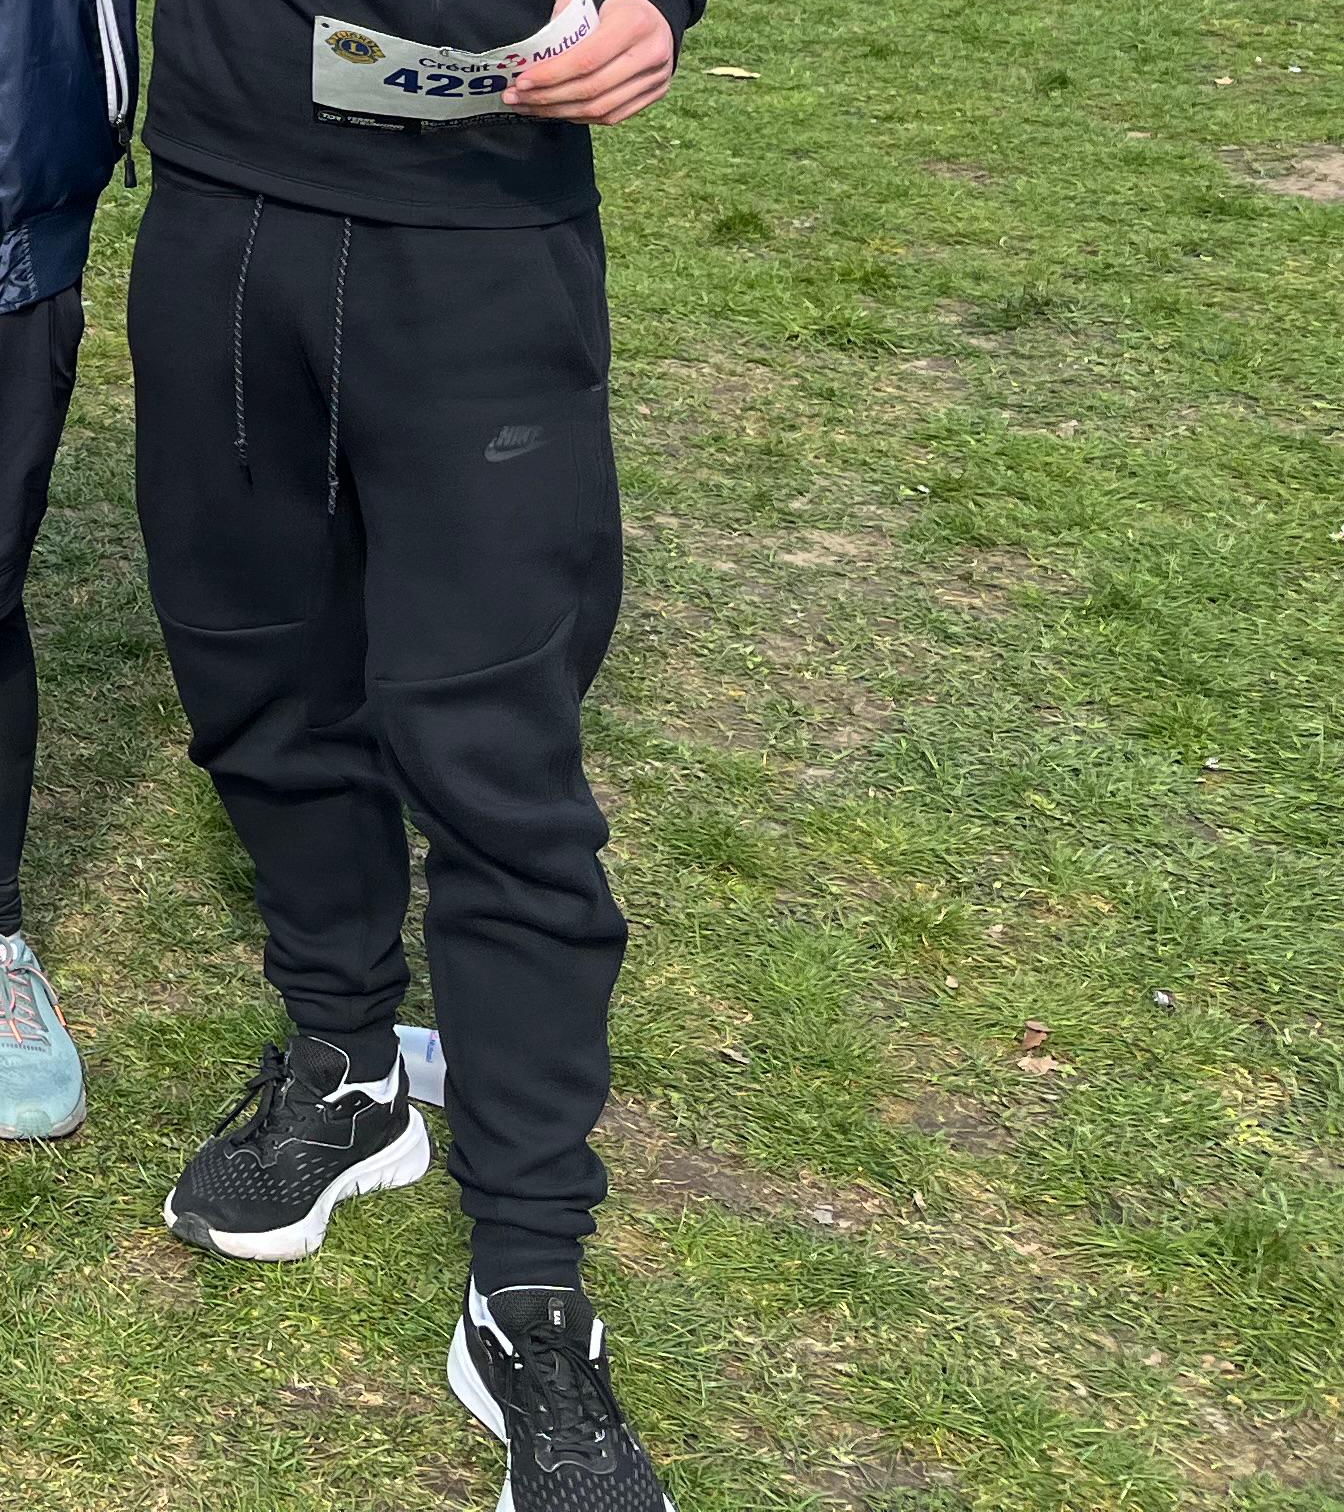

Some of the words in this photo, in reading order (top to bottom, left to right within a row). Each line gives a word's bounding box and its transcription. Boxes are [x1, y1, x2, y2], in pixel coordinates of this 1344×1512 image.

[418, 58, 491, 73] Crédit
[533, 15, 592, 63] Mutuel
[383, 67, 524, 98] 429
